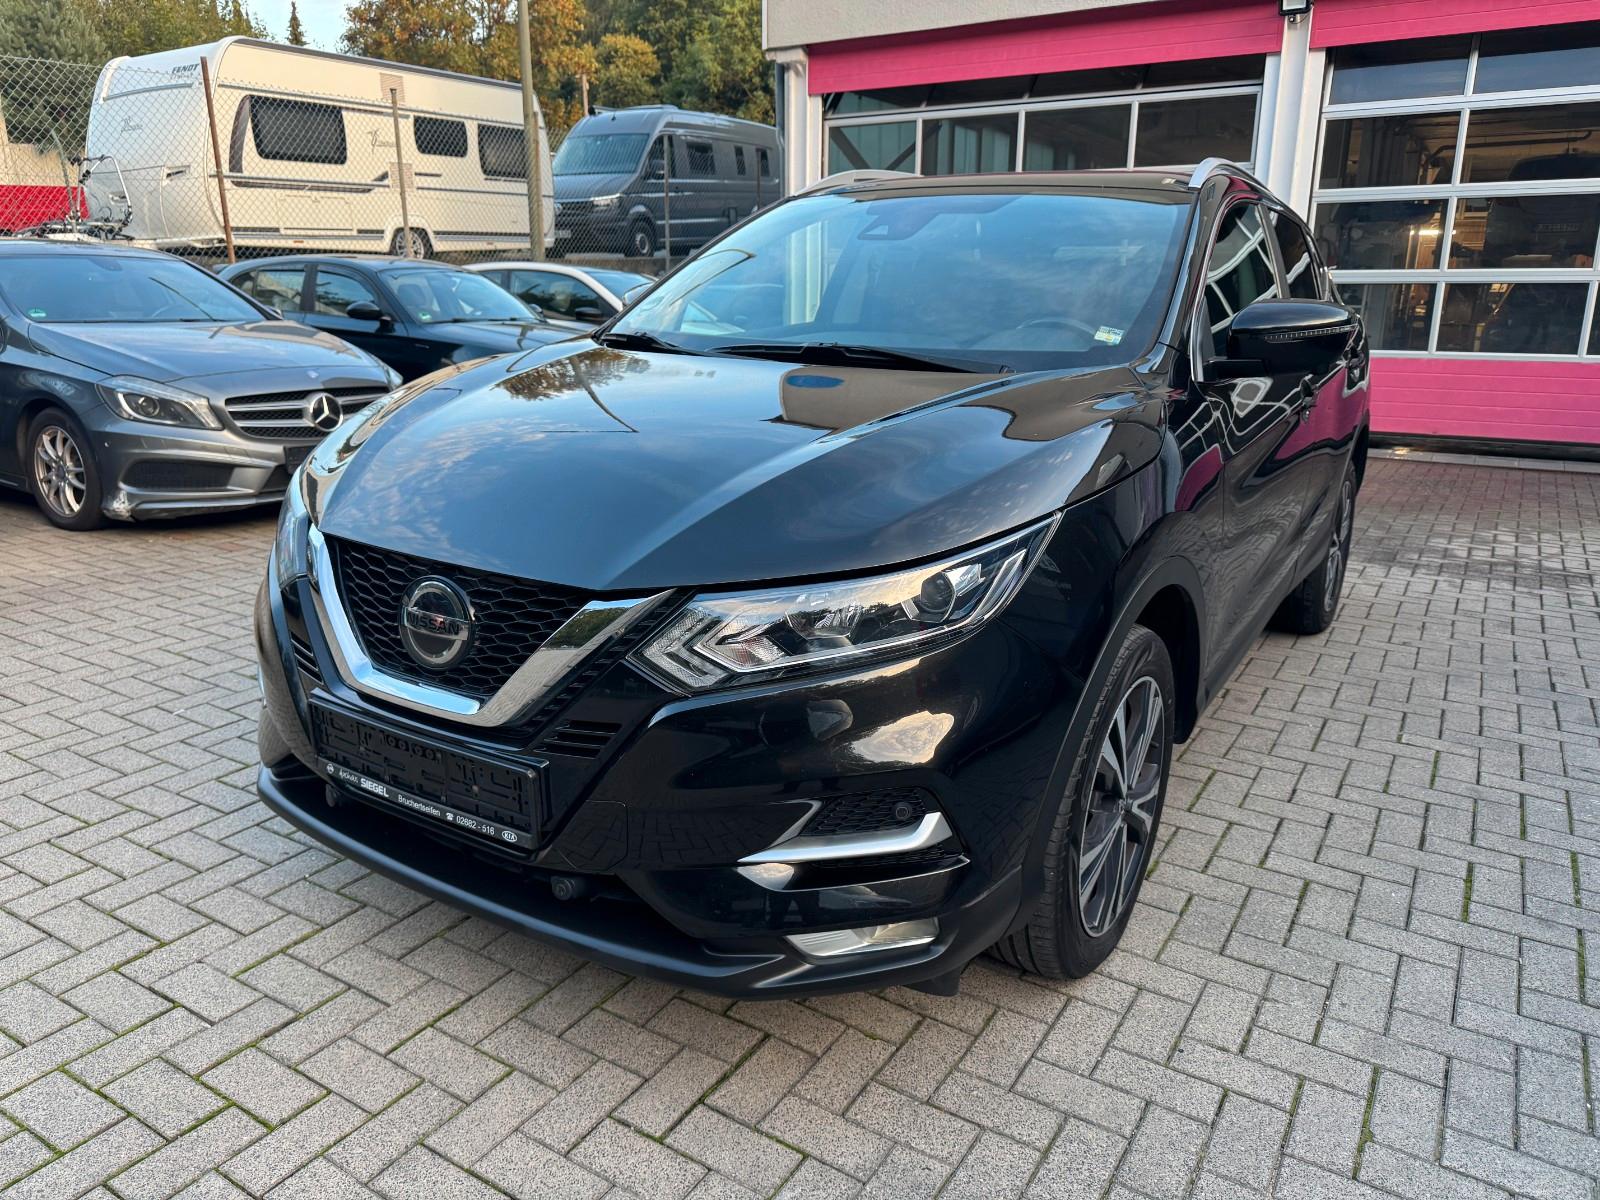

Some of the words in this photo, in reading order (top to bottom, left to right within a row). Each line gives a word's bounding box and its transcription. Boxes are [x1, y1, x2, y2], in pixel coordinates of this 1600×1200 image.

[171, 63, 200, 73] FENDT
[407, 612, 459, 635] NISSAN
[360, 777, 389, 798] SIEGEL
[456, 815, 477, 830] 02682
[482, 824, 495, 836] 516
[503, 831, 516, 841] KIA
